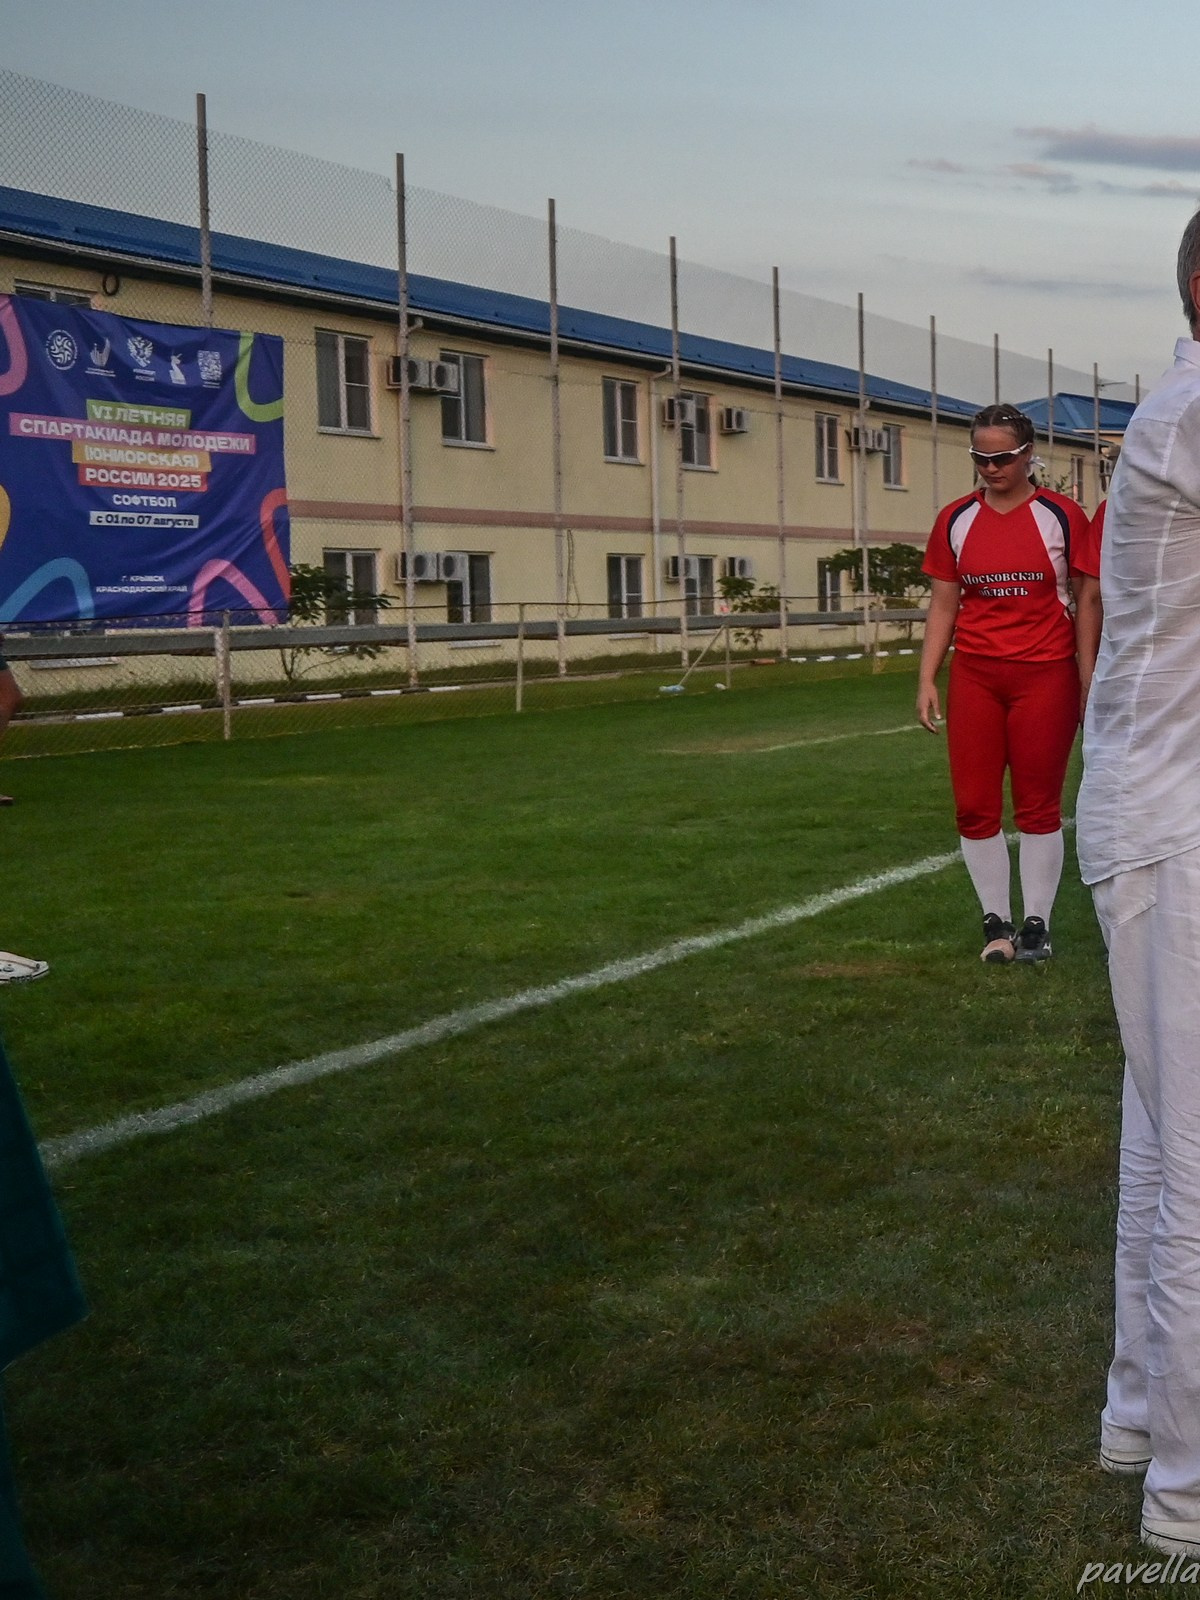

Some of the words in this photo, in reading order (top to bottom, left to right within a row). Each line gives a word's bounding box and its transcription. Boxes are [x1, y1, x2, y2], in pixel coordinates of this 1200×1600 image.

[115, 408, 186, 427] ЛЕТНЯЯ
[20, 418, 154, 446] СПАРТАКИАДА
[157, 432, 250, 451] МОЛОДЕЖИ
[85, 468, 155, 486] РОССИИ
[157, 474, 202, 488] 2025
[112, 494, 177, 508] СОФТБОЛ
[105, 514, 119, 524] 01
[120, 517, 135, 525] по
[136, 515, 152, 525] 07
[153, 518, 194, 528] августа
